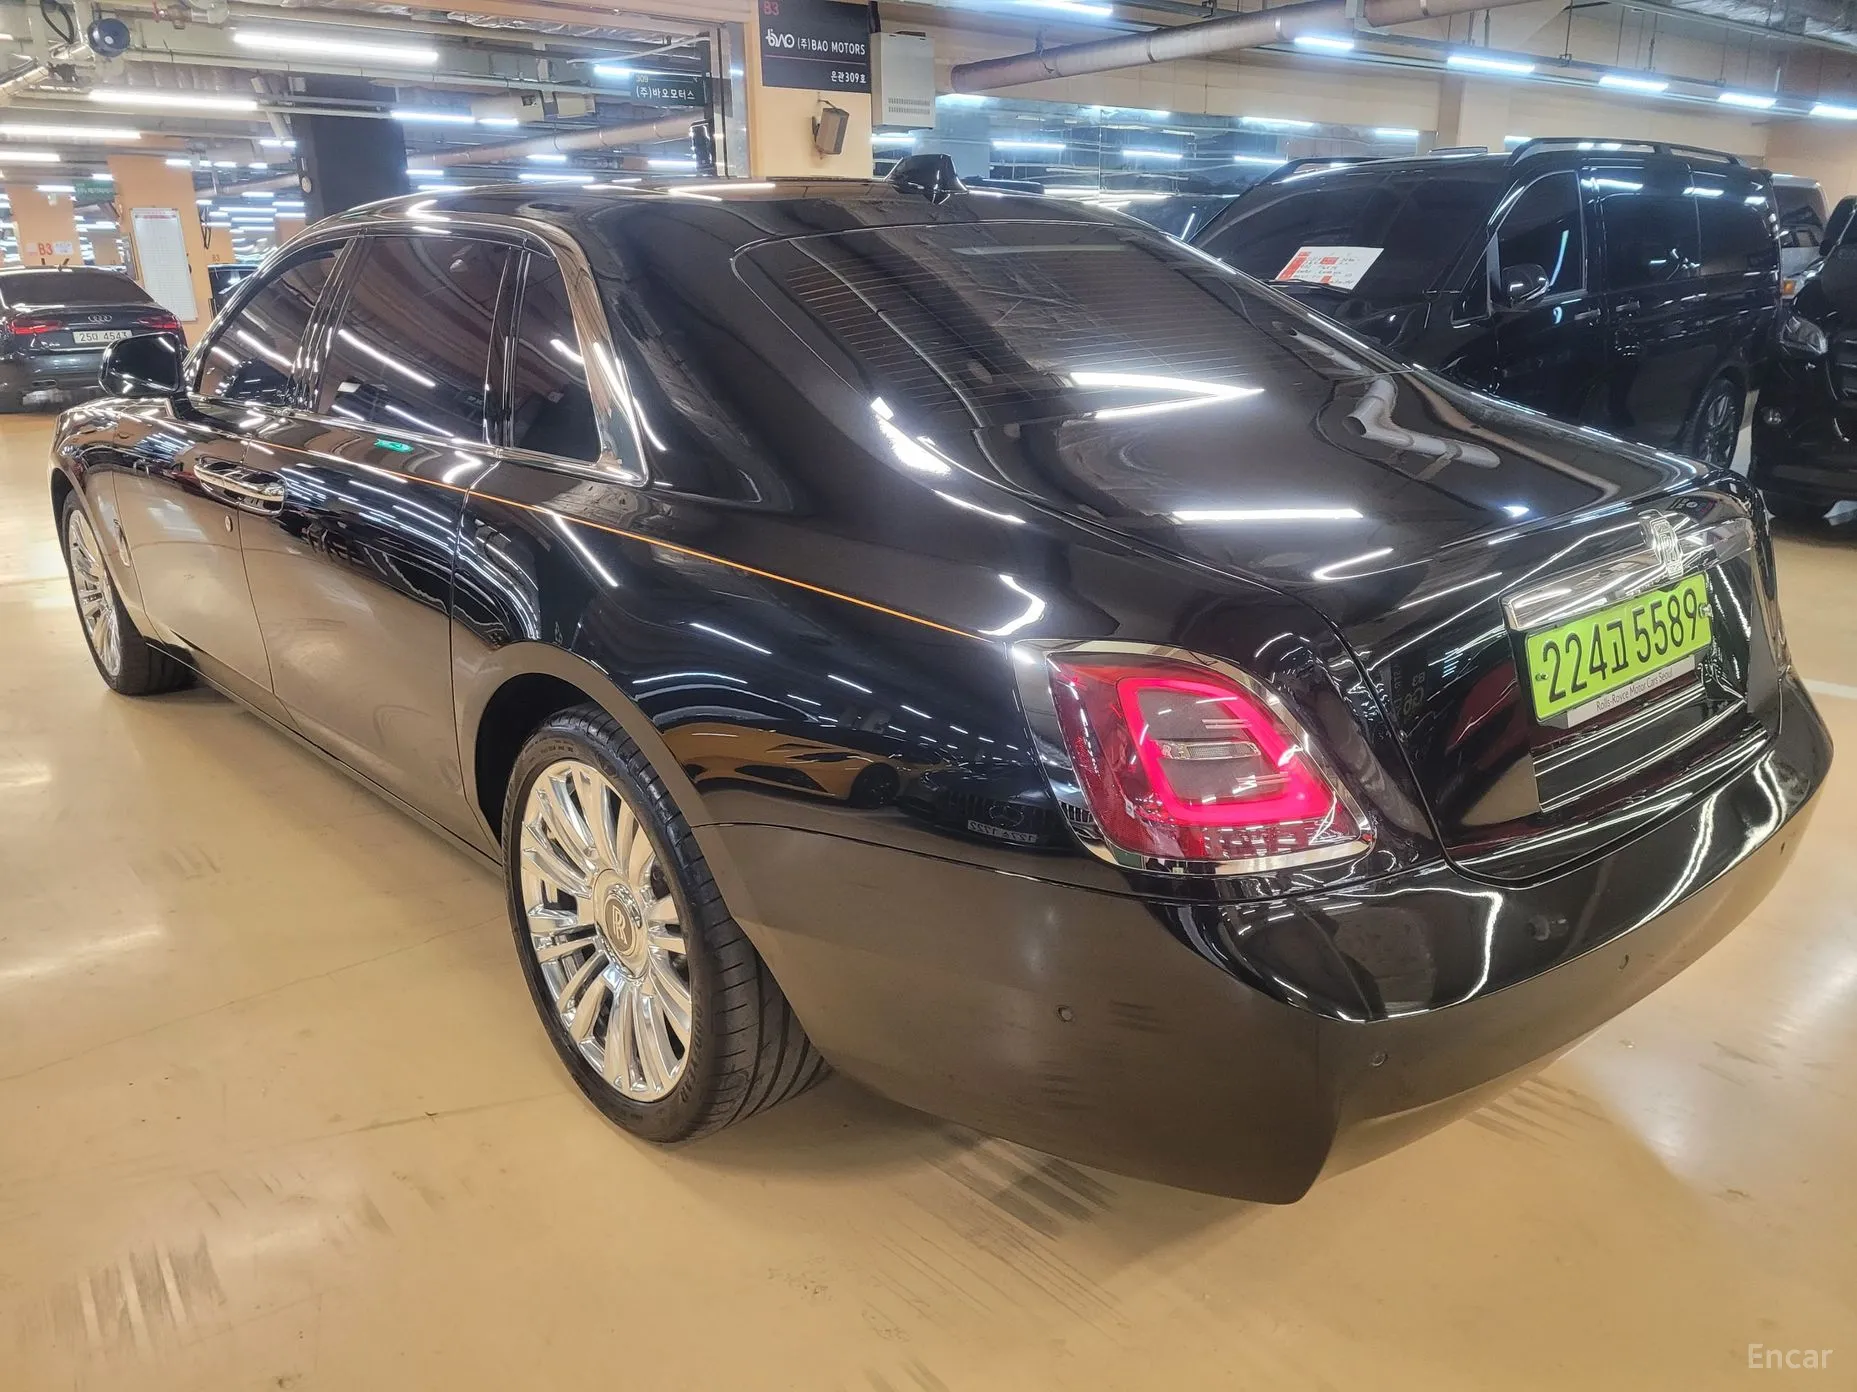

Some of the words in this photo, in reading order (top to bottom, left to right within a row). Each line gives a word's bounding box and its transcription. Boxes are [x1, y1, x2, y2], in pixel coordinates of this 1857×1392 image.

[831, 42, 866, 56] MOTORS
[635, 85, 696, 100] (주)바오모터스
[38, 243, 53, 256] B3
[1631, 587, 1698, 664] 5589
[1596, 690, 1629, 712] Rolls-Royce
[1629, 682, 1646, 697] Motor
